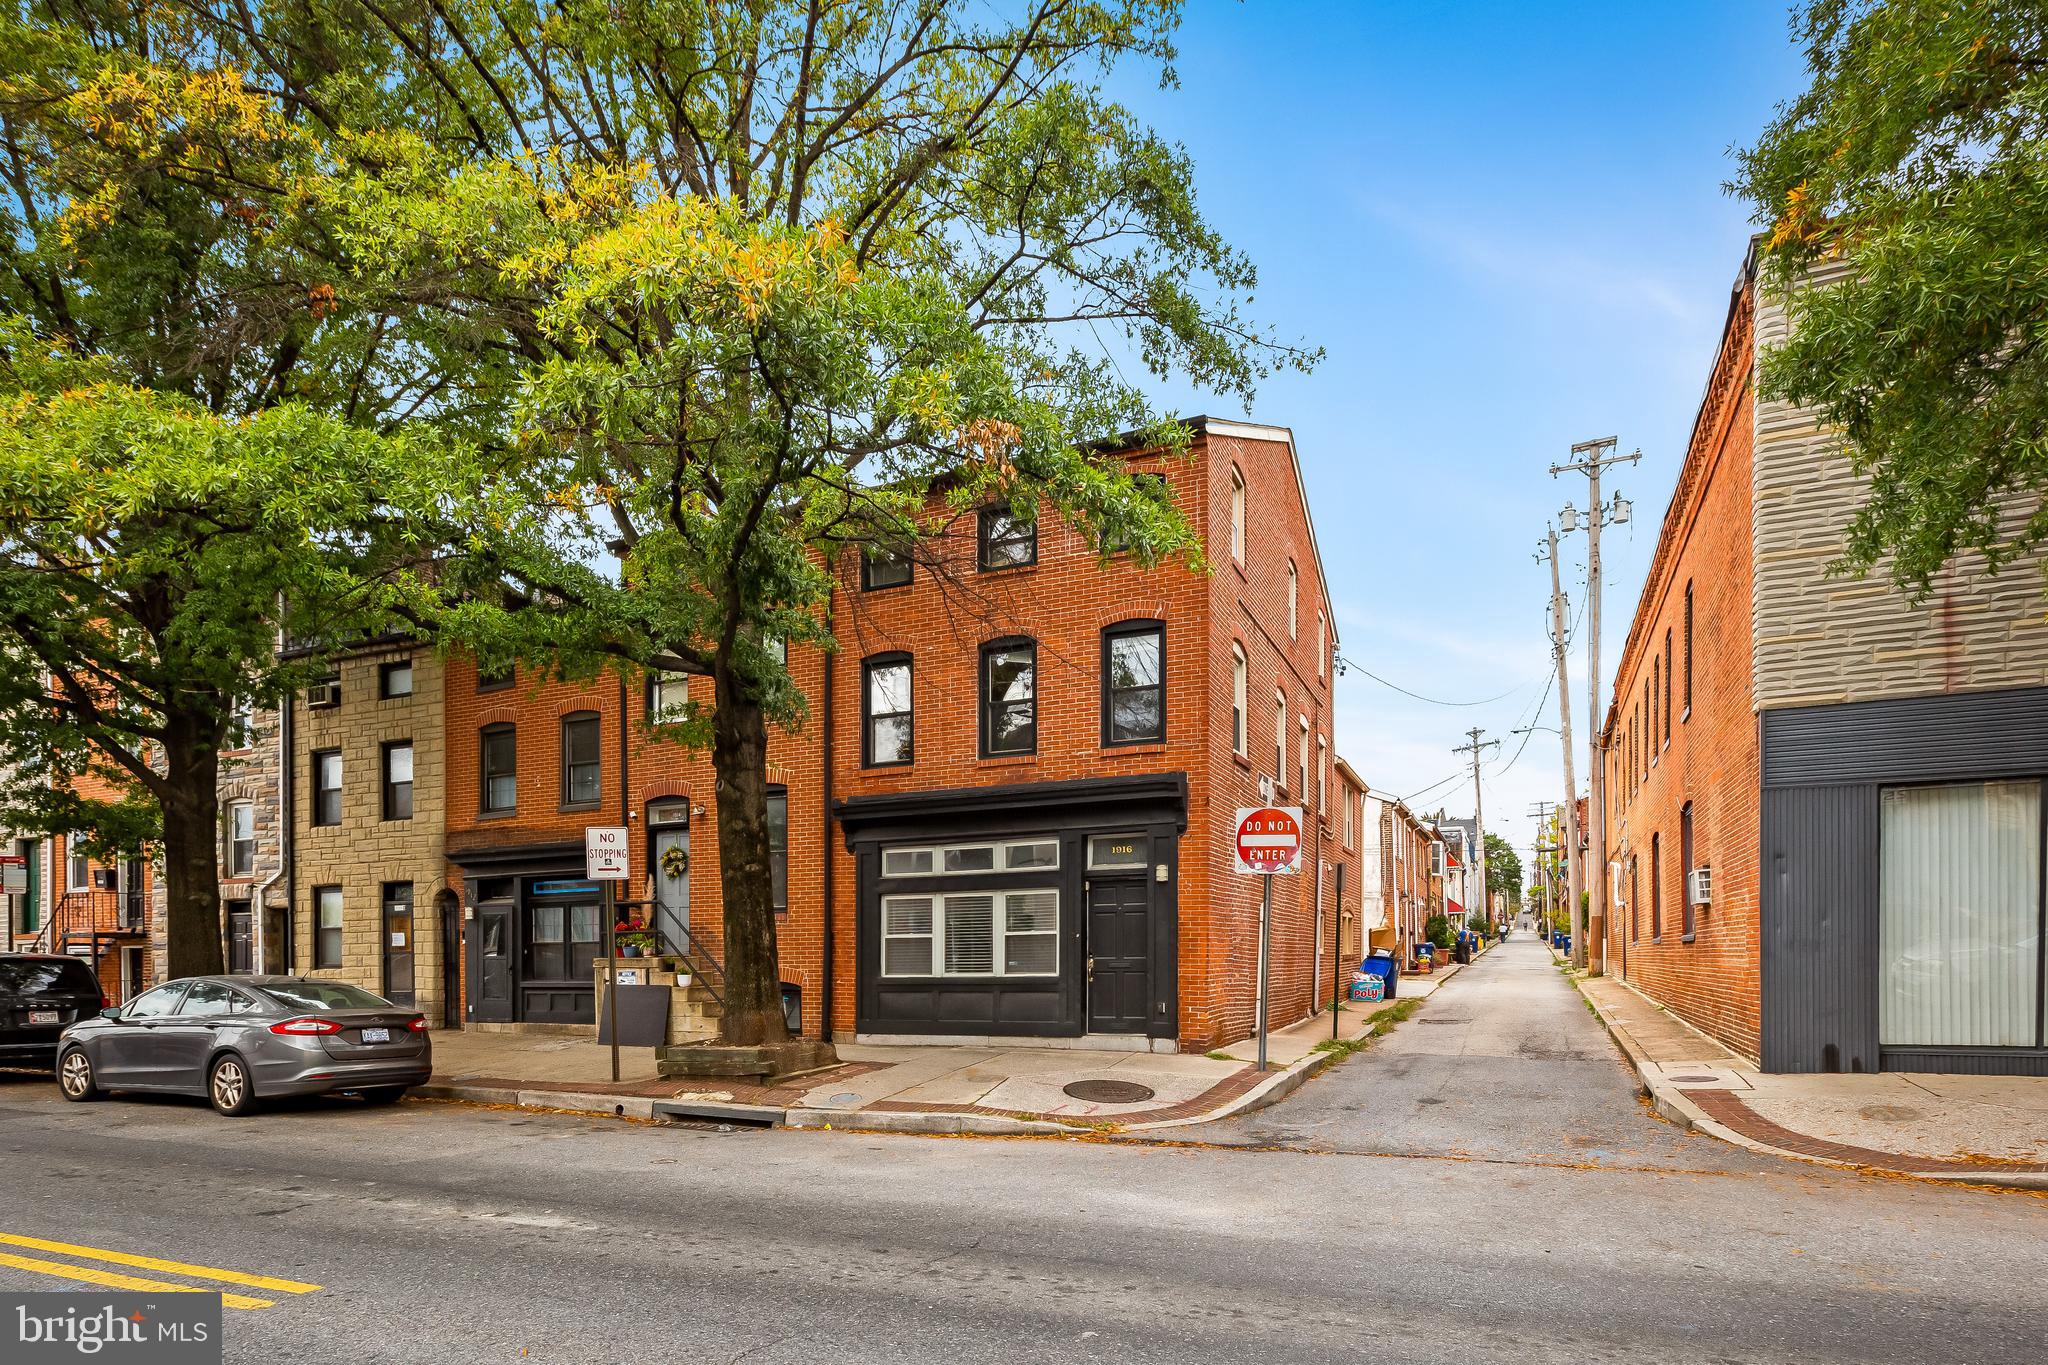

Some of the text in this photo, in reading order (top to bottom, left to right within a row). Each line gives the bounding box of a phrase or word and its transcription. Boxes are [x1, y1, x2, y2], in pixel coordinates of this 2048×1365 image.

[1246, 820, 1292, 832] DO NOT
[599, 833, 615, 843] NO
[589, 848, 627, 859] STOPPING
[1111, 845, 1133, 854] 1916
[1249, 849, 1286, 860] ENTER
